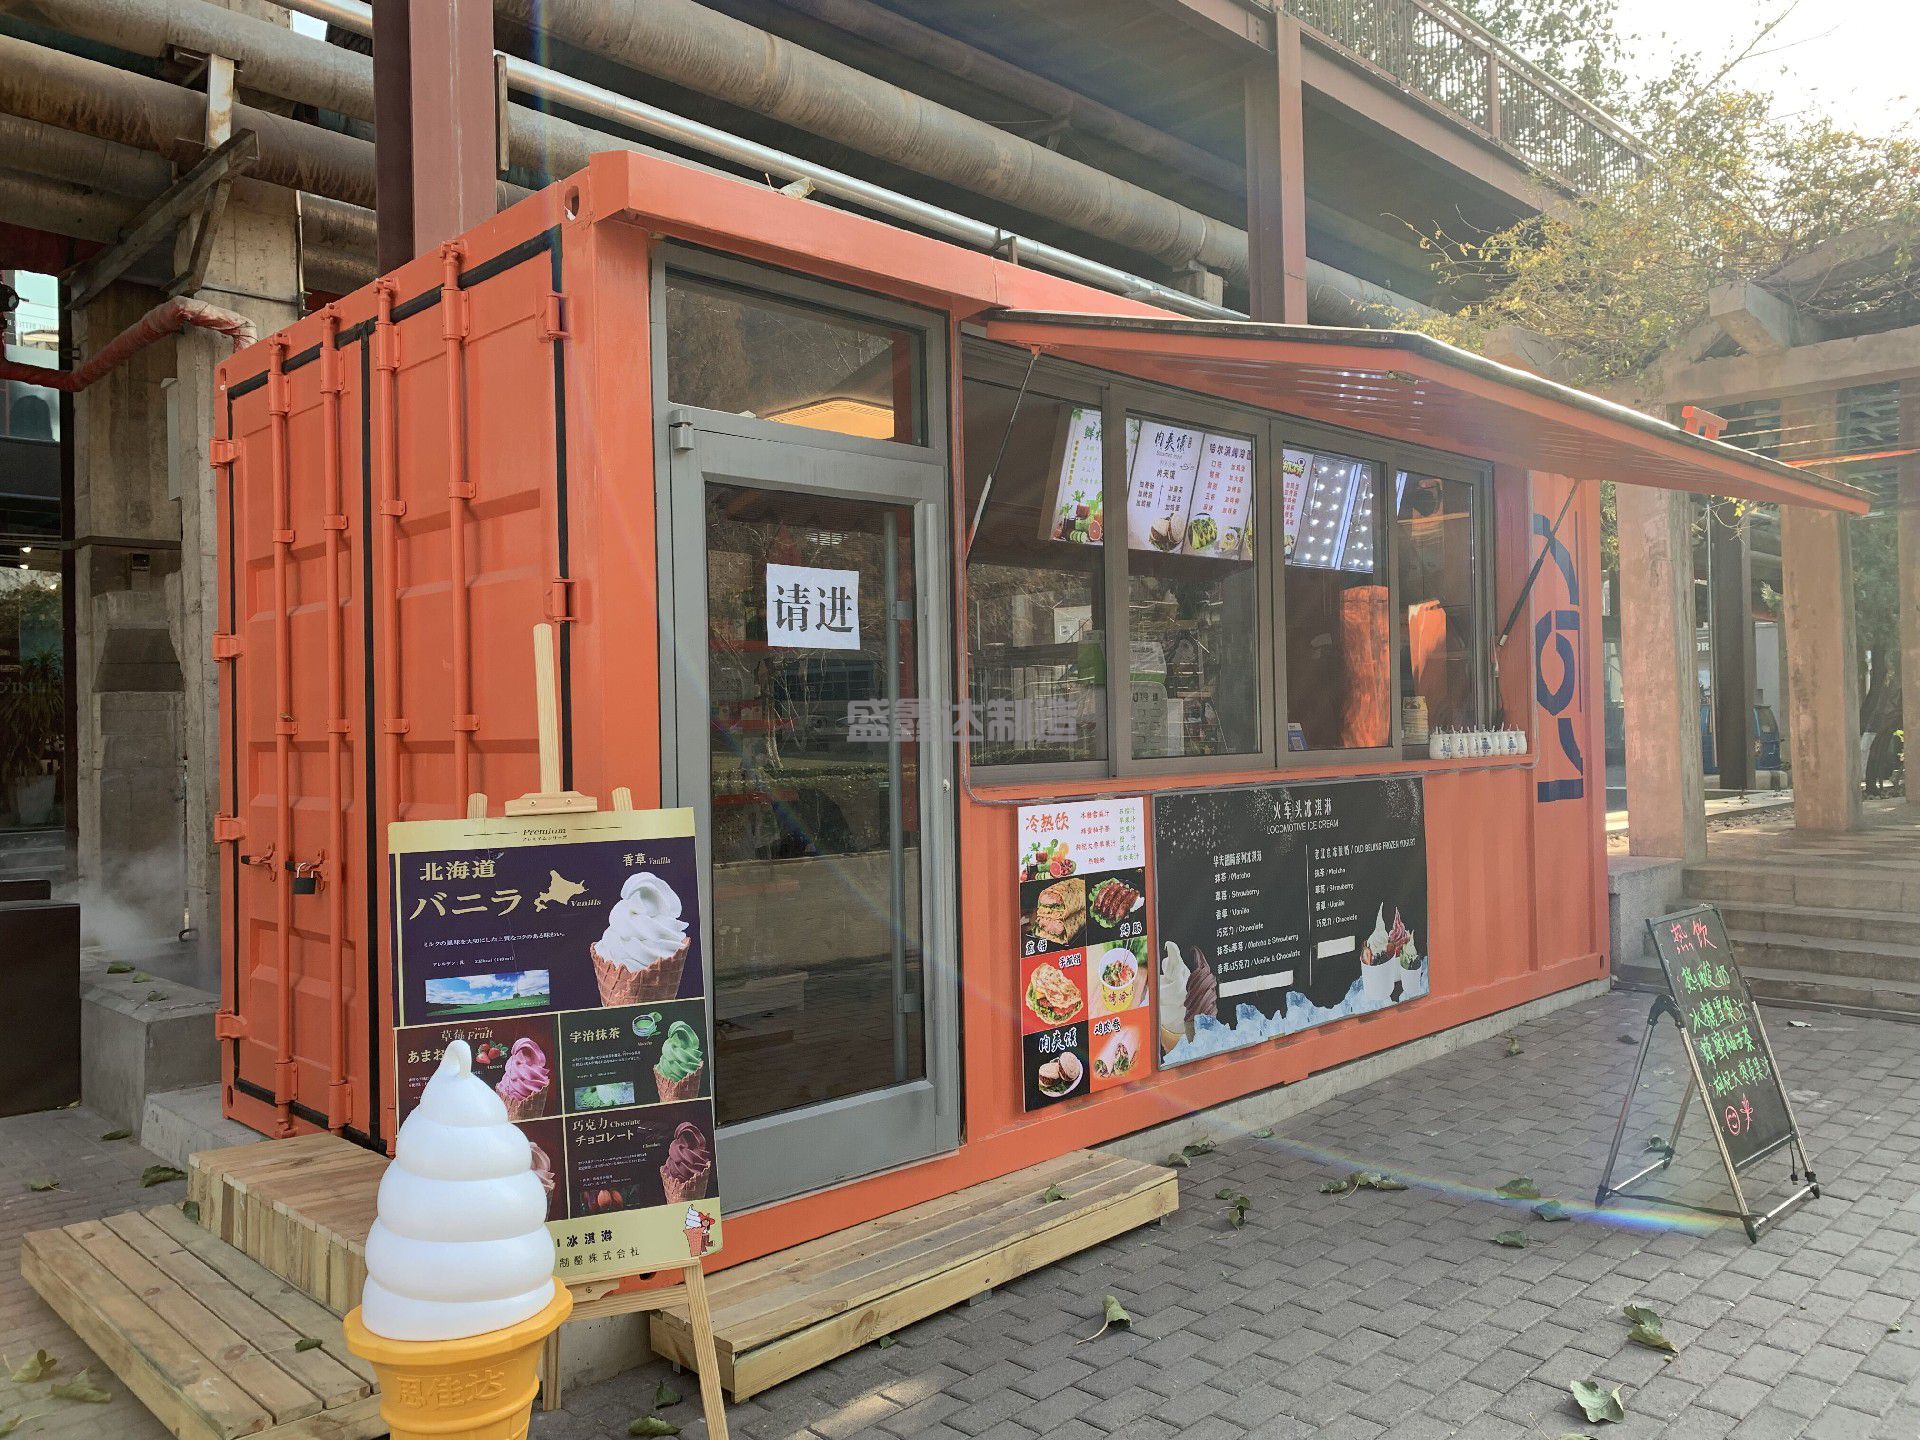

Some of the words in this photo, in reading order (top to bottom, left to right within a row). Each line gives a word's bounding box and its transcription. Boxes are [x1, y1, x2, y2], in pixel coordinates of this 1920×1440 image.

[772, 583, 854, 632] 请进
[1273, 797, 1332, 820] 火车头冰淇淋
[1025, 811, 1070, 833] 冷热饮
[1267, 821, 1307, 835] LOCOMOTIVE
[1307, 821, 1318, 831] ICE
[1318, 819, 1339, 829] CREAM
[523, 827, 567, 835] Premium
[1314, 844, 1350, 860] 老北京冻酸奶
[1354, 844, 1364, 854] OLD
[1382, 840, 1400, 850] FROZEN
[1399, 838, 1416, 848] YOGURT
[622, 852, 646, 867] 香草
[648, 856, 671, 865] Vanilla
[419, 859, 497, 882] 北海道
[1214, 872, 1227, 883] 抹茶
[1230, 871, 1251, 881] Matcha
[1314, 867, 1325, 878] 抹茶
[1328, 867, 1346, 875] Matcha
[1215, 890, 1227, 901] 草莓
[1231, 888, 1260, 898] Strawberry
[1314, 884, 1326, 894] 草莓
[409, 888, 523, 921] バニラ
[570, 899, 602, 908] Vanilla
[1315, 900, 1327, 911] 香草
[1215, 908, 1228, 920] 香草
[1231, 907, 1250, 916] Vanilla
[1216, 926, 1234, 938] 巧克力
[1238, 921, 1264, 932] Chocolate
[1316, 917, 1332, 928] 巧克力
[1247, 940, 1267, 949] Matcha
[1271, 934, 1299, 944] Strawberry
[1670, 918, 1718, 955] 热饮
[1058, 953, 1081, 968] 手抓饼
[1275, 949, 1301, 960] Chocolate
[1680, 960, 1731, 995] 热酸奶
[1689, 995, 1748, 1034] 冰糖雪梨汁
[1093, 1016, 1121, 1036] 鸡肉卷
[467, 1029, 494, 1041] Fruit
[569, 1027, 620, 1044] 宇治抹茶
[1038, 1027, 1078, 1053] 肉夹馍
[1700, 1024, 1756, 1069] 蜂蜜柚子茶
[1713, 1055, 1772, 1098] 枸杞大枣苹果汁
[572, 1117, 608, 1132] 巧克力
[575, 1129, 634, 1146] チョコレート
